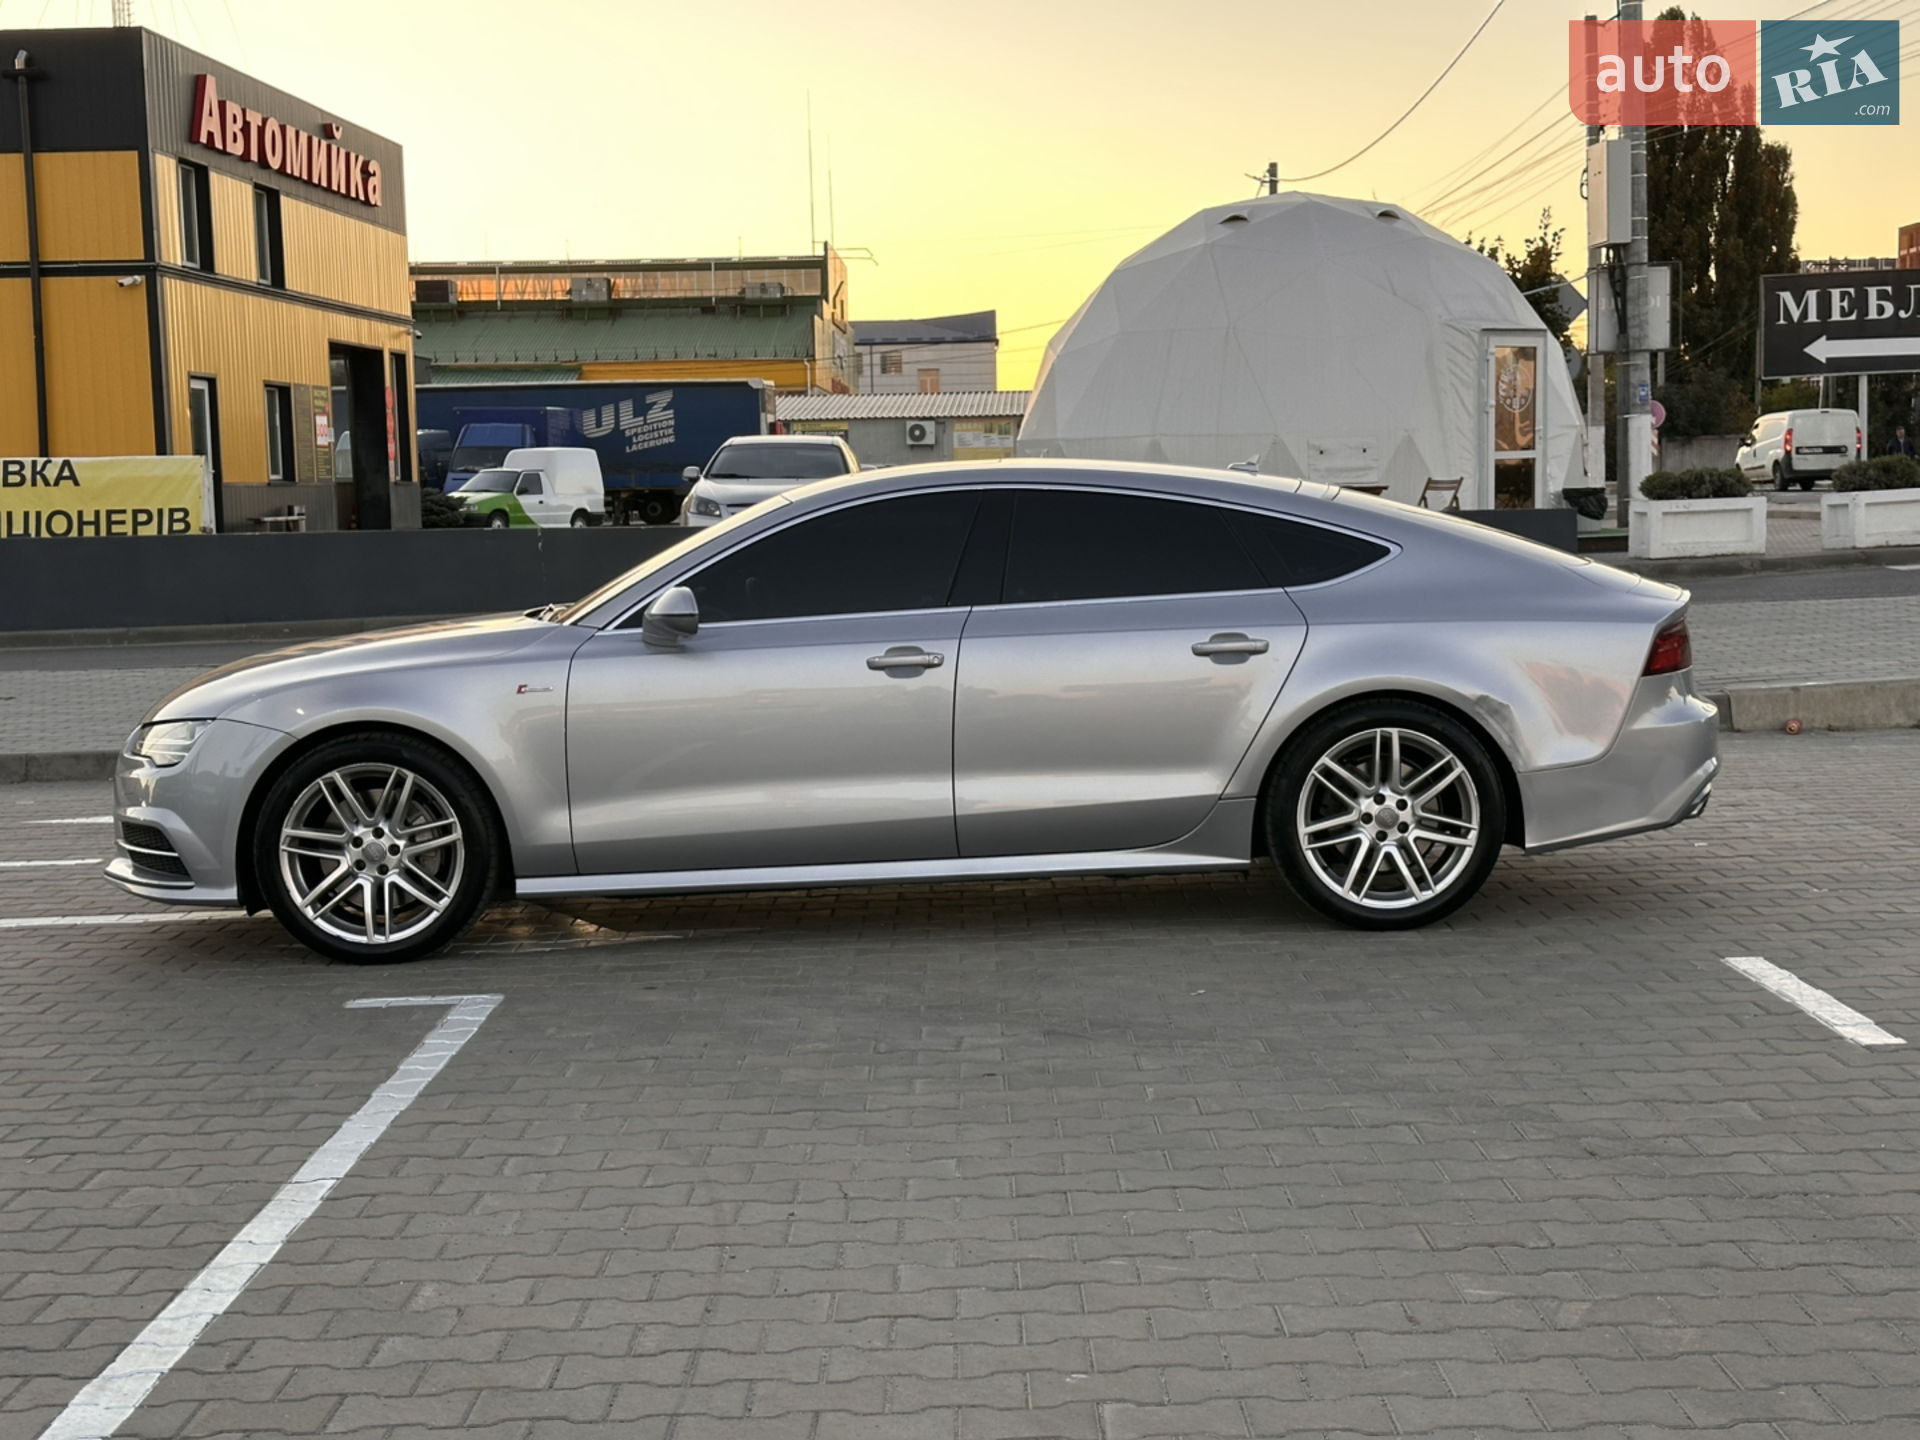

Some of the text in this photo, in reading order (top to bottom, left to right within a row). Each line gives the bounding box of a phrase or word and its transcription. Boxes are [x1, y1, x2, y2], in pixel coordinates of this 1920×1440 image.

[194, 73, 382, 207] Автомийка
[582, 389, 675, 438] ULZ
[624, 418, 675, 437] SPEDITION
[625, 435, 676, 453] LAGERUNG
[632, 427, 675, 444] LOGISTIK
[2, 459, 81, 487] ВКА
[0, 507, 192, 538] ЦІОНЕРІВ
